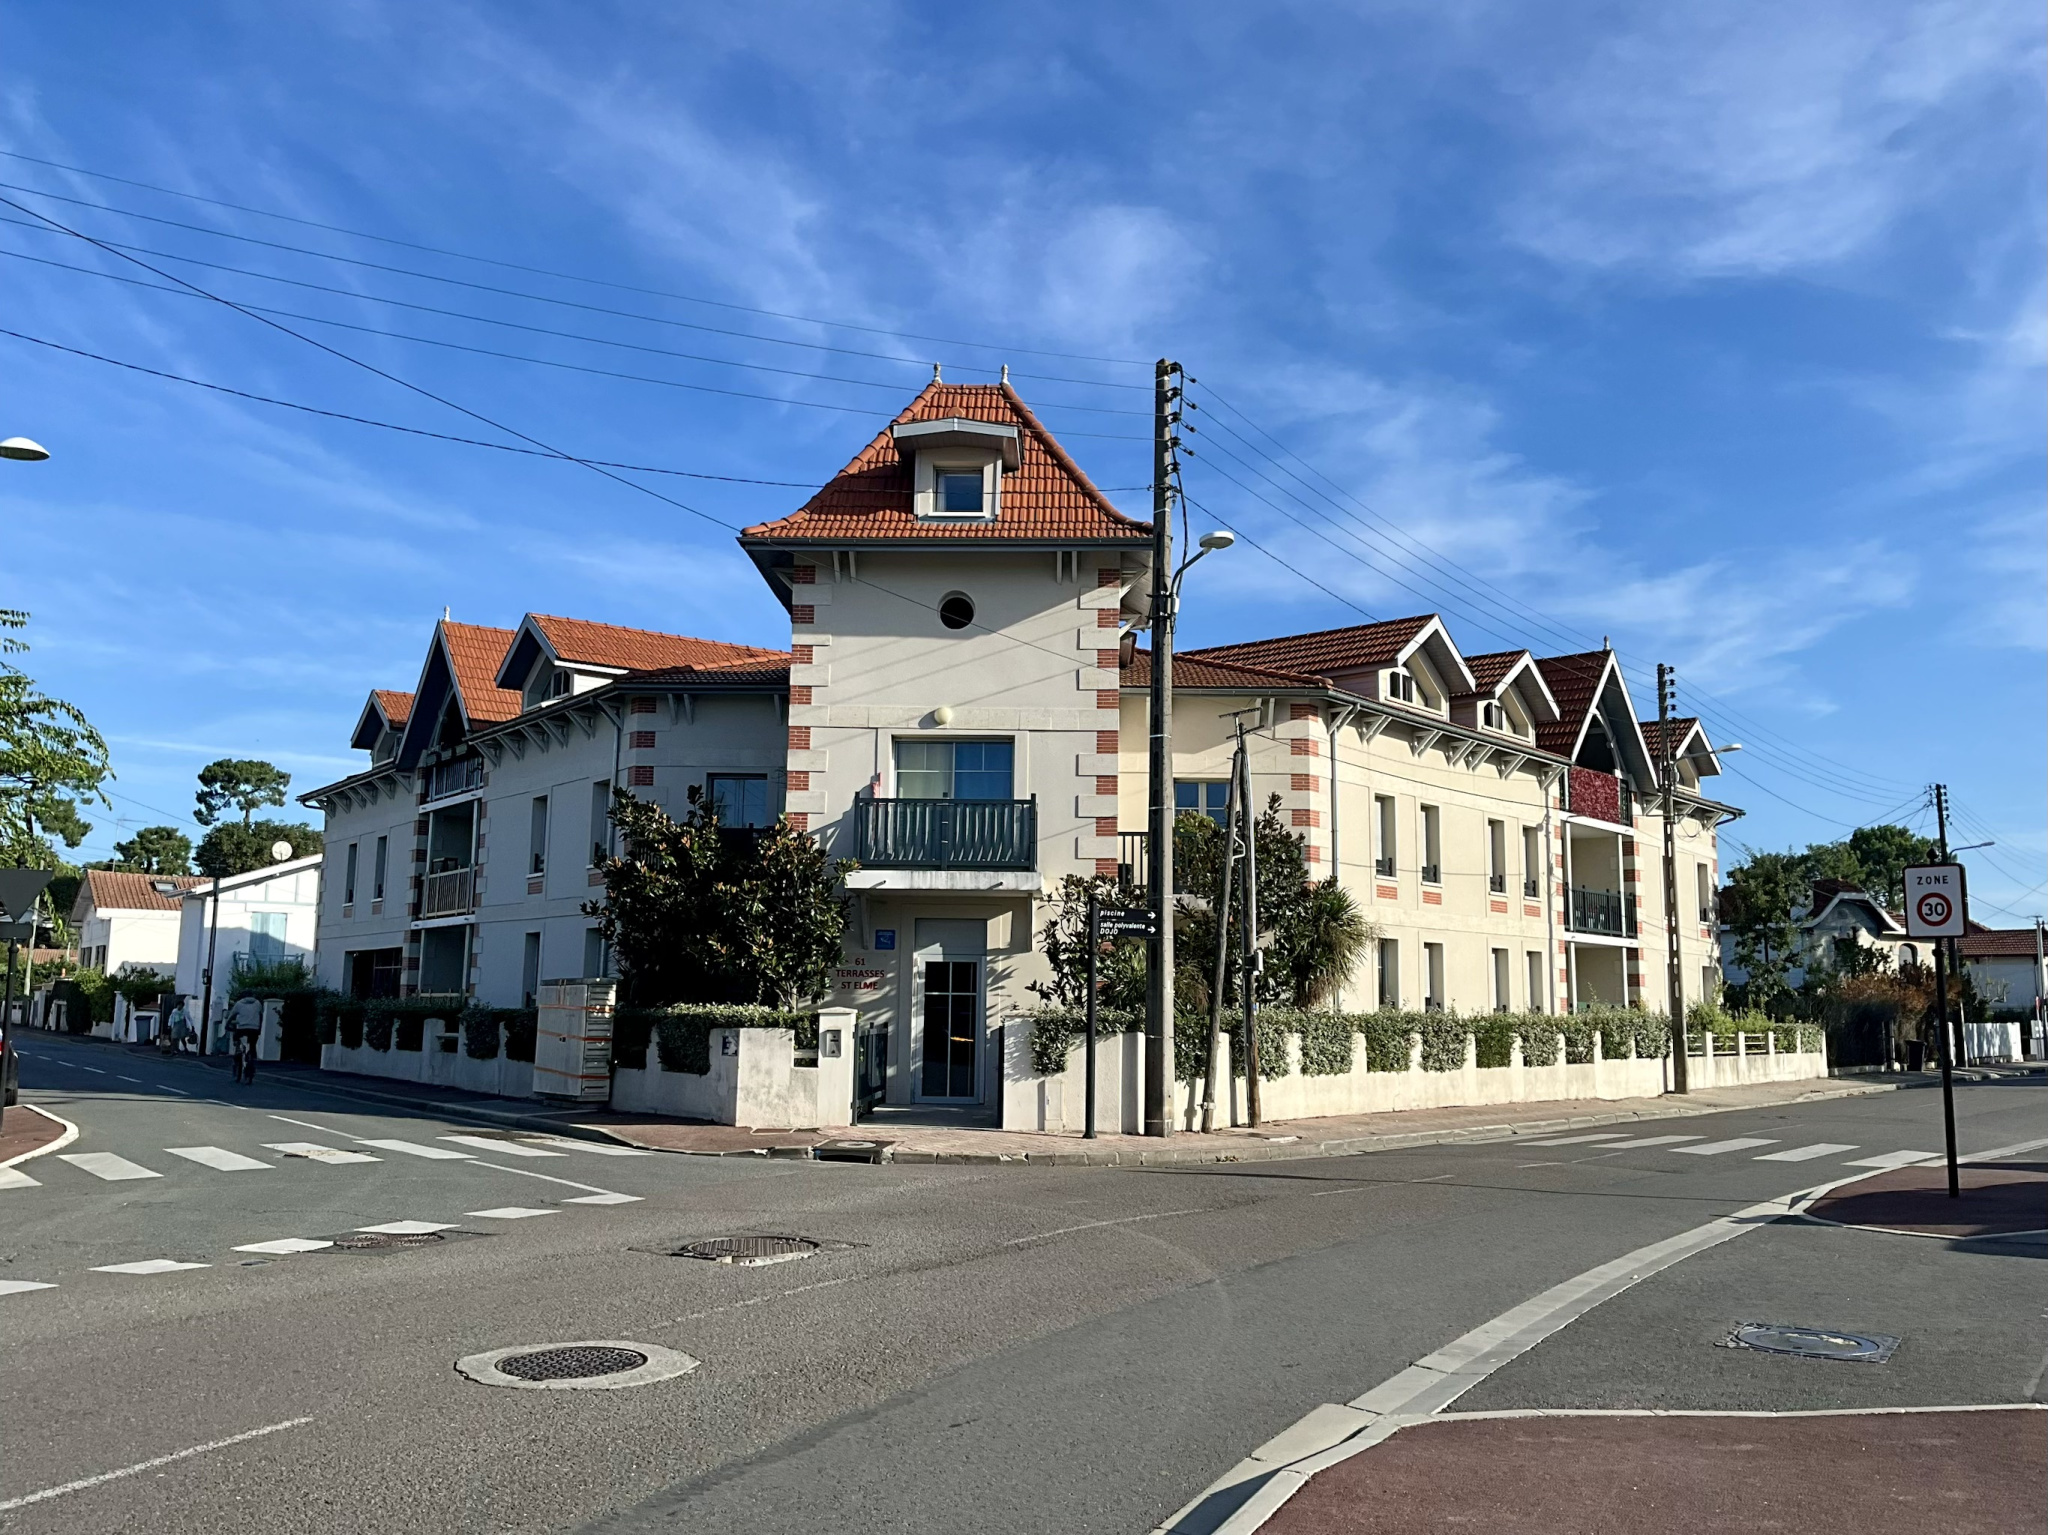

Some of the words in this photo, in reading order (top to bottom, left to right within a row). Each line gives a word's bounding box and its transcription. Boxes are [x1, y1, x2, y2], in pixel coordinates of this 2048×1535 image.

[1916, 875, 1949, 886] ZONE
[1924, 902, 1945, 917] 30
[855, 957, 866, 966] 61
[835, 969, 885, 978] TERRASSES
[841, 981, 852, 990] ST
[854, 981, 879, 990] ELME
